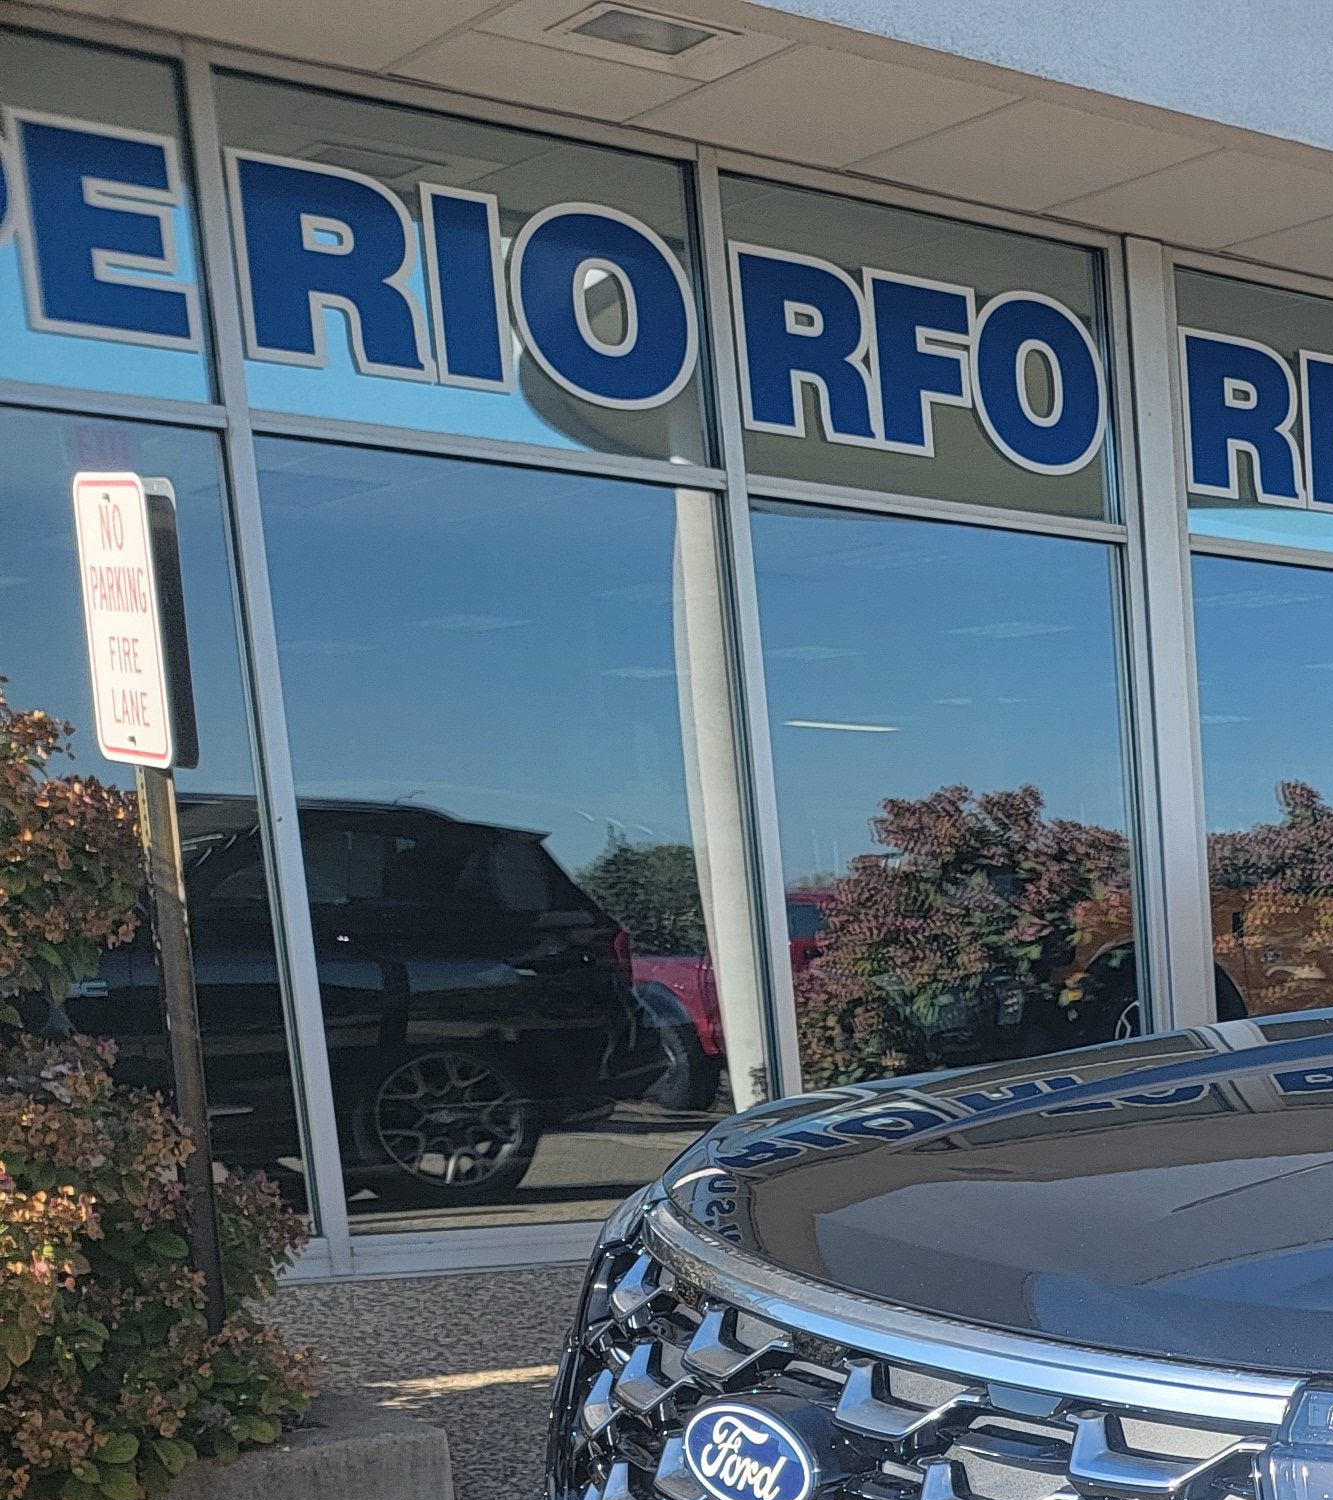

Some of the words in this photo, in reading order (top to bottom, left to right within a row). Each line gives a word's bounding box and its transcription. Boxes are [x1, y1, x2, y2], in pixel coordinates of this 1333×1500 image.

[98, 503, 124, 551] NO
[89, 566, 148, 614] PARKING
[108, 636, 142, 675] FIRE
[111, 687, 151, 728] LANE
